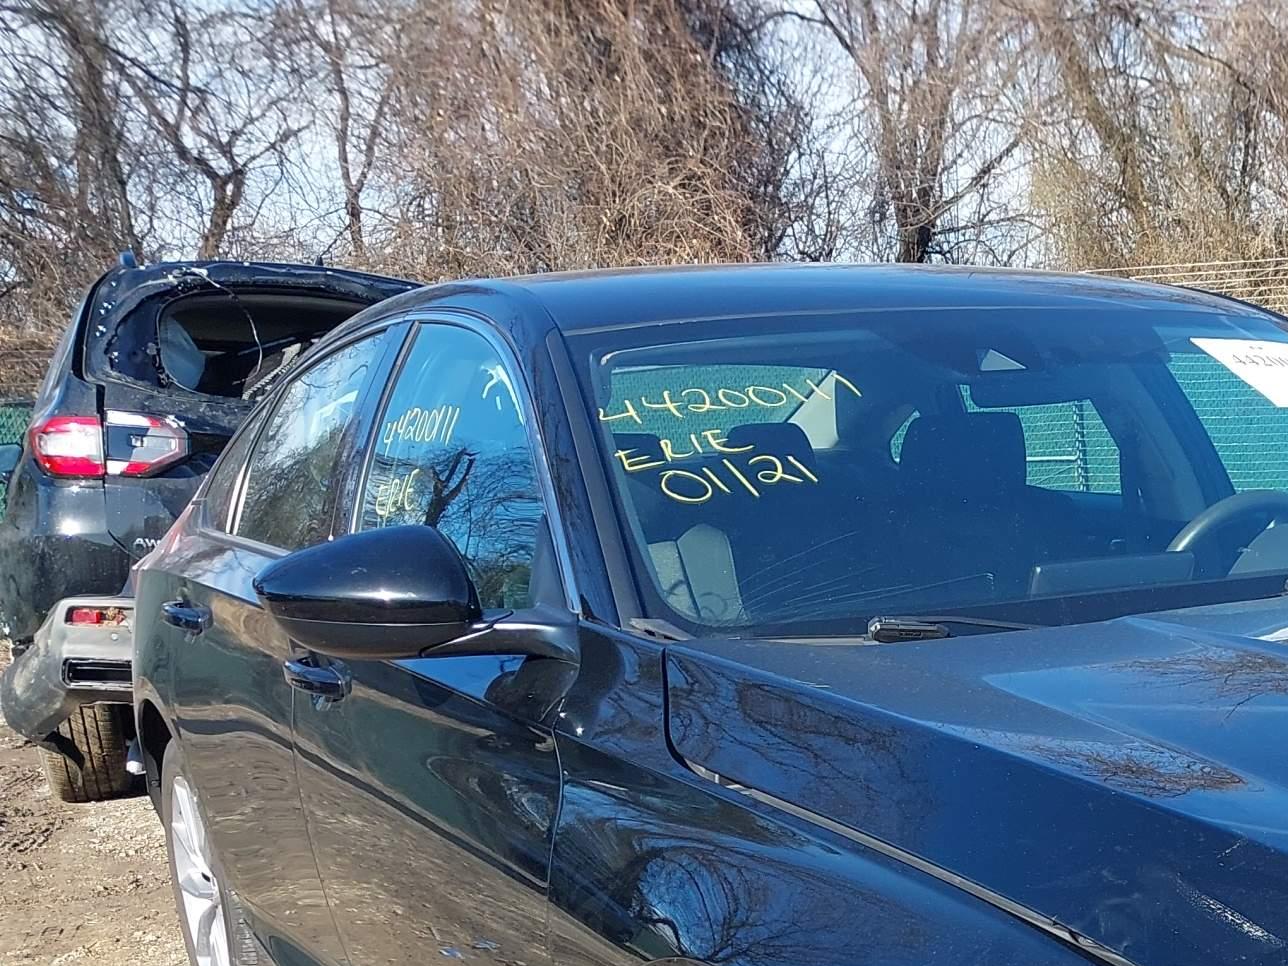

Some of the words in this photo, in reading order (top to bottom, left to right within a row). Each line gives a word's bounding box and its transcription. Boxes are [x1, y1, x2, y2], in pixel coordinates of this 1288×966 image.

[598, 371, 863, 424] 44200111
[383, 405, 460, 459] 44200111
[614, 429, 755, 473] ERIE
[659, 455, 819, 503] 01/21
[133, 537, 160, 548] AW
